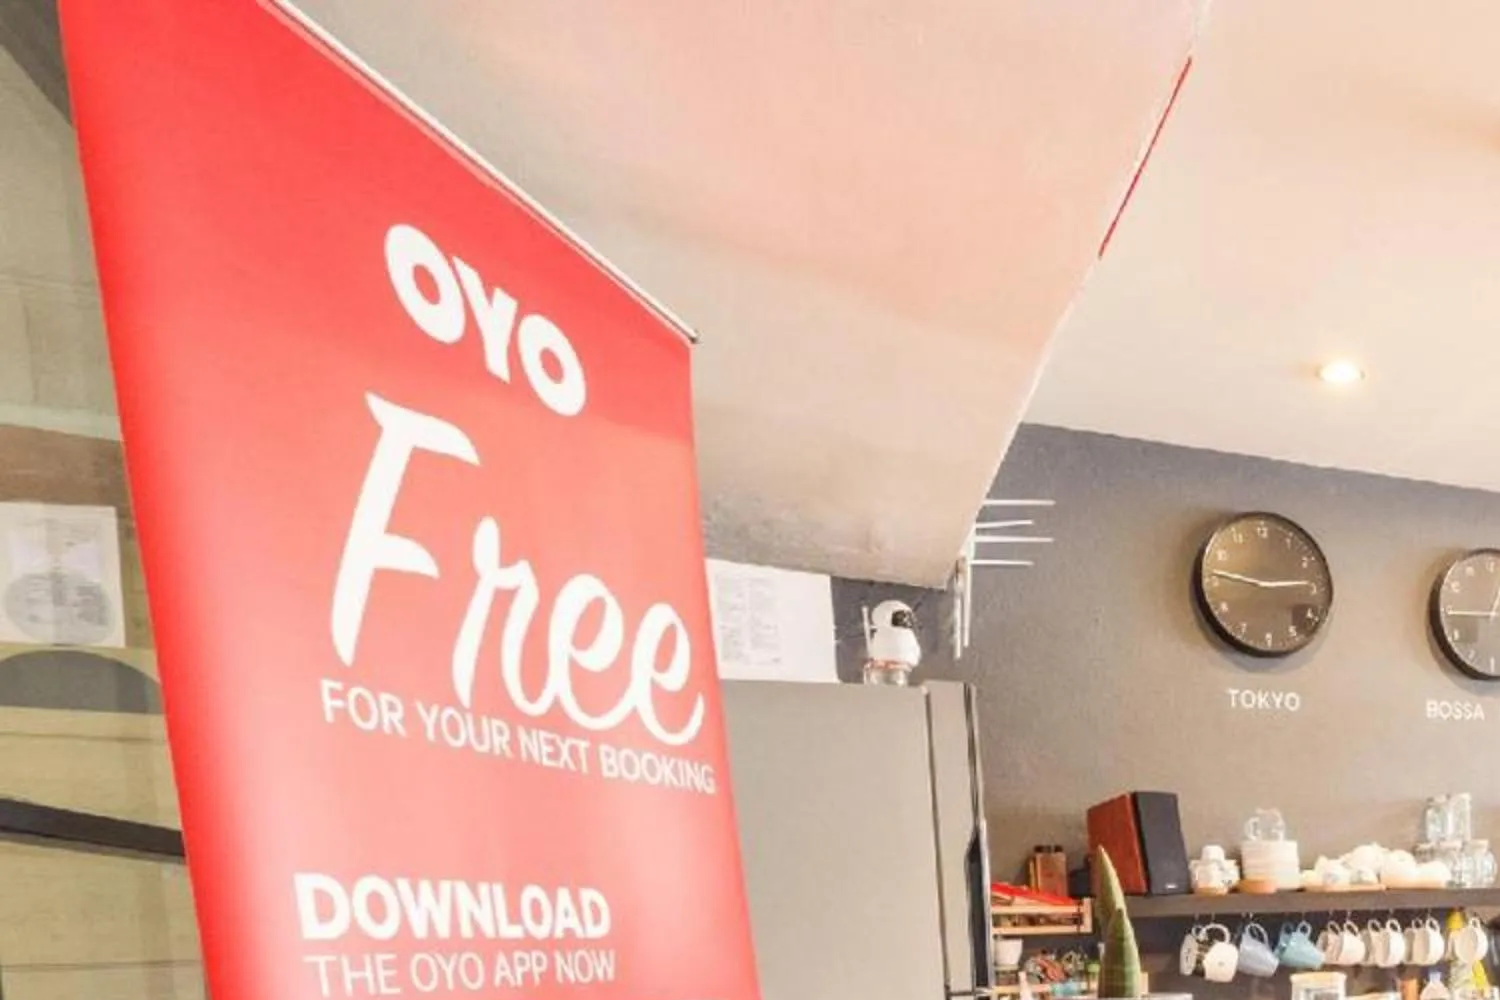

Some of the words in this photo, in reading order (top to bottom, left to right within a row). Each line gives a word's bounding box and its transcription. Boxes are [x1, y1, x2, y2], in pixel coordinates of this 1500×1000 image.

[384, 223, 586, 417] OYO
[331, 391, 704, 746] Free
[1226, 688, 1301, 712] TOKYO
[1426, 700, 1486, 722] BOSSA
[320, 678, 406, 737] FOR
[416, 700, 511, 759] YOUR
[518, 724, 590, 774] NEXT
[600, 744, 715, 796] BOOKING
[293, 872, 612, 942] DOWNLOAD
[303, 952, 402, 998] THE
[410, 951, 484, 993] OYO
[494, 950, 548, 988] APP
[555, 948, 616, 984] NOW
